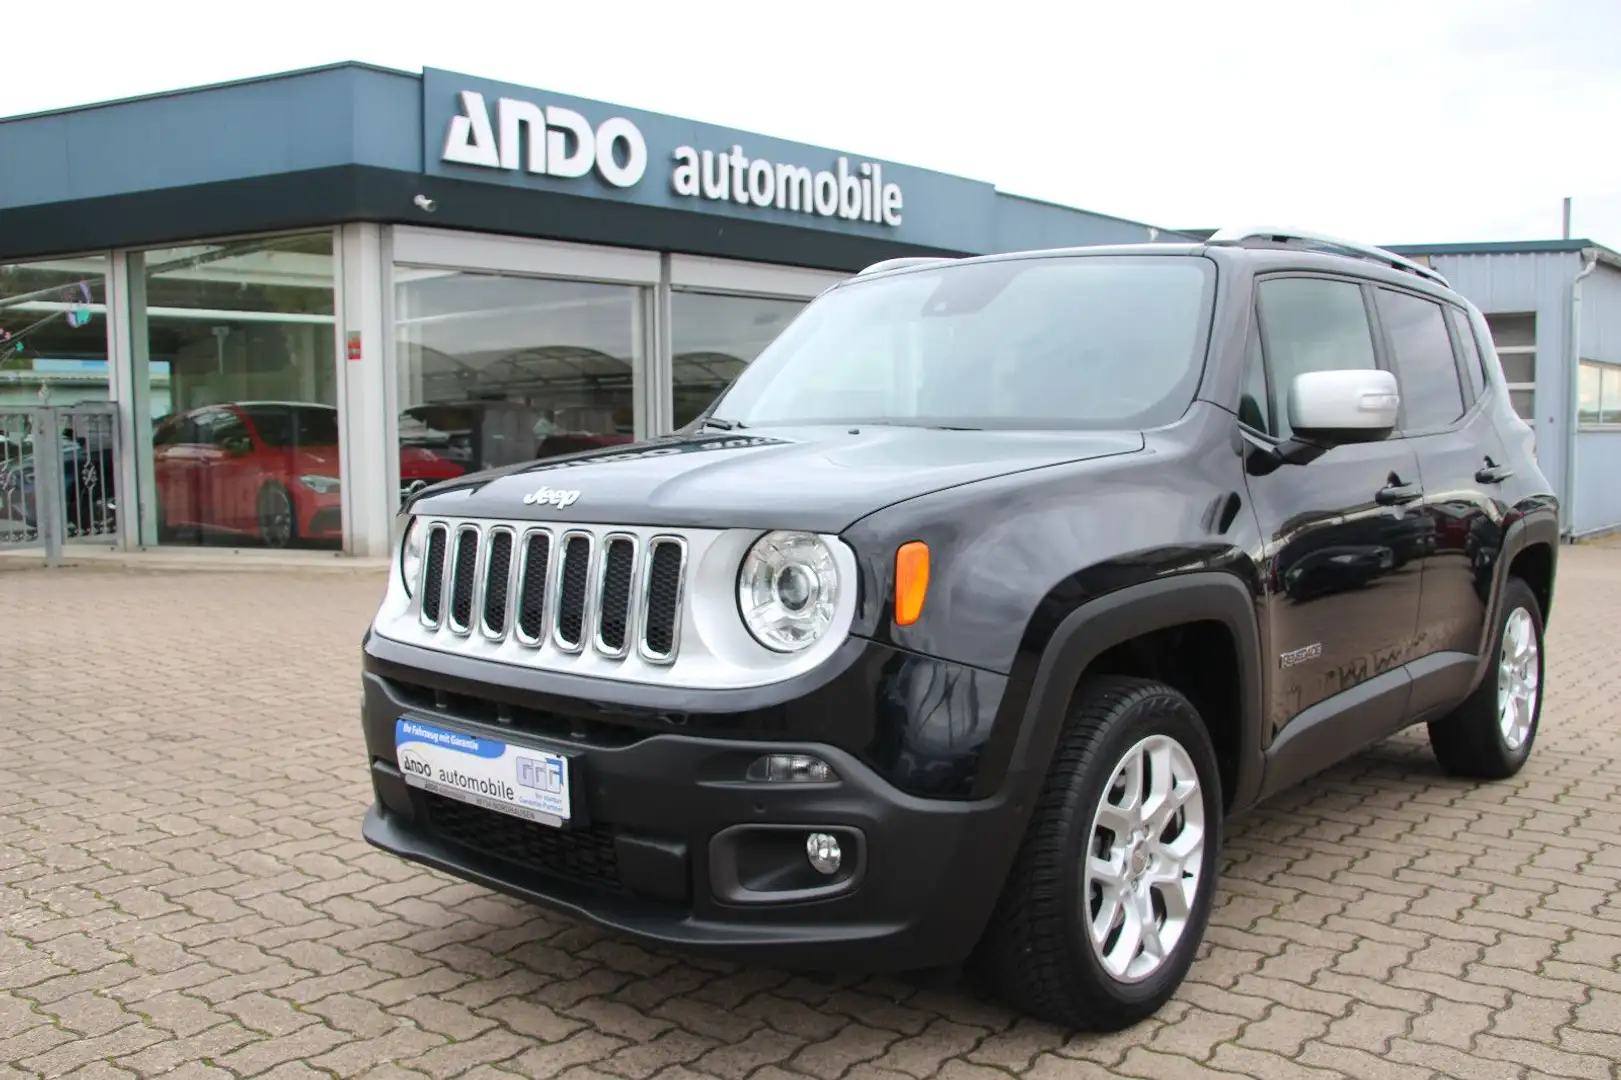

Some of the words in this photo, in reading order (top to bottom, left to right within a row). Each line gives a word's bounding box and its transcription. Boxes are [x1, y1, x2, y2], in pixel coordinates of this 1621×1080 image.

[672, 144, 904, 227] automobile
[523, 486, 580, 510] Jeep
[411, 725, 439, 743] Fahrzeug
[438, 733, 450, 744] mit
[449, 735, 479, 751] Garantie
[439, 768, 514, 801] automobile
